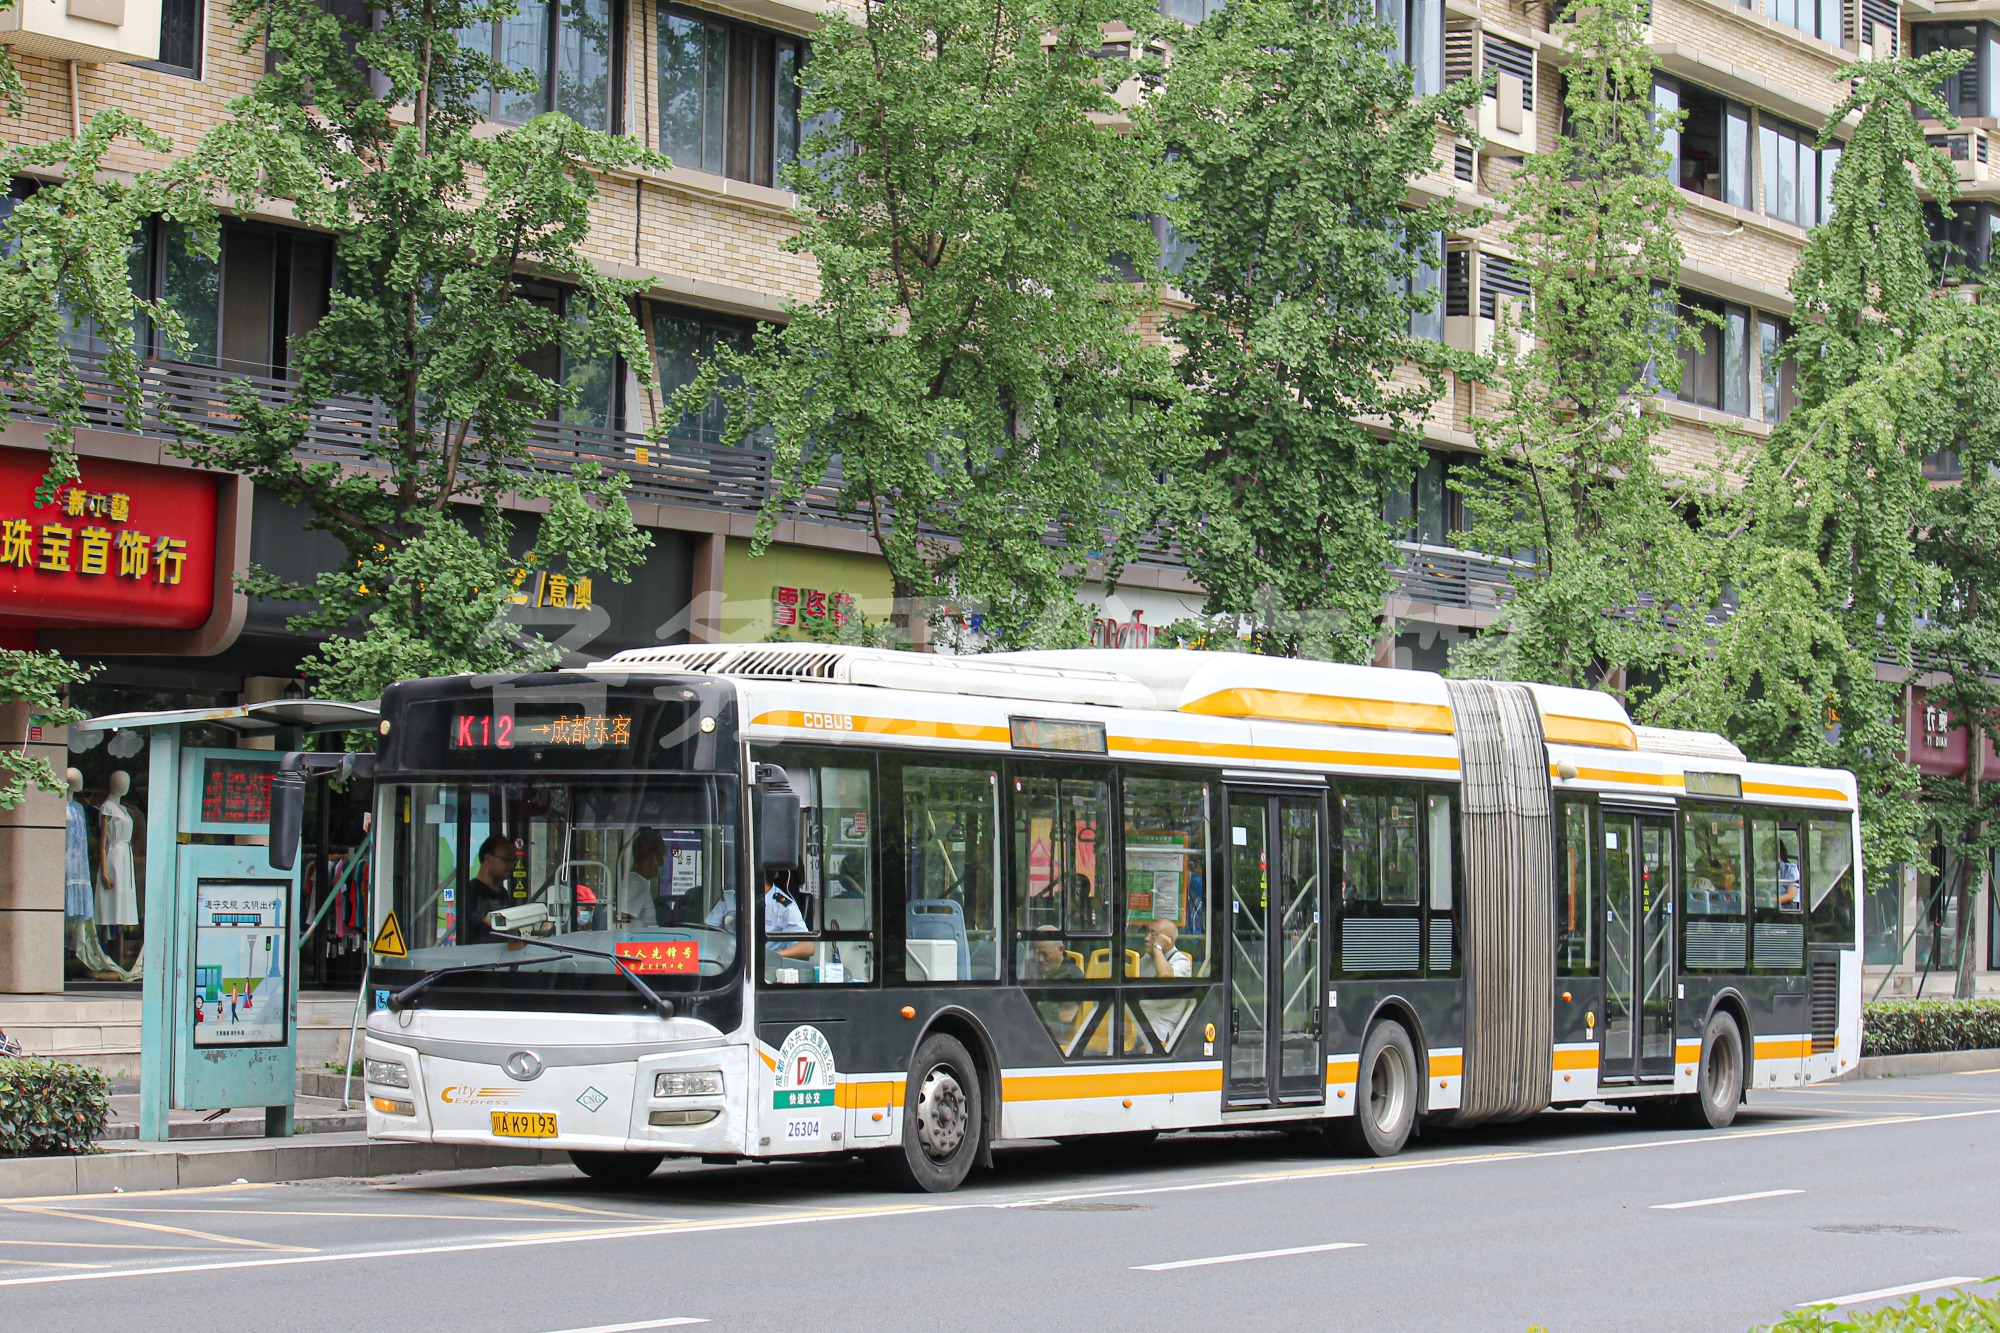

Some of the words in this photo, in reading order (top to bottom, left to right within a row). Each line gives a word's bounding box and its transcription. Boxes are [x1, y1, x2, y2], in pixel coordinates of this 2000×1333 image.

[0, 518, 187, 584] 珠宝首饰行
[458, 715, 513, 747] K12
[550, 714, 632, 746] 成都东客
[242, 900, 276, 910] 文明出行
[774, 1027, 836, 1088] 成都市公共交通集团公司
[441, 1083, 477, 1104] City
[455, 1097, 509, 1105] Express
[582, 1093, 602, 1105] CNG
[788, 1092, 821, 1106] 快速公交
[788, 1120, 819, 1137] 26304
